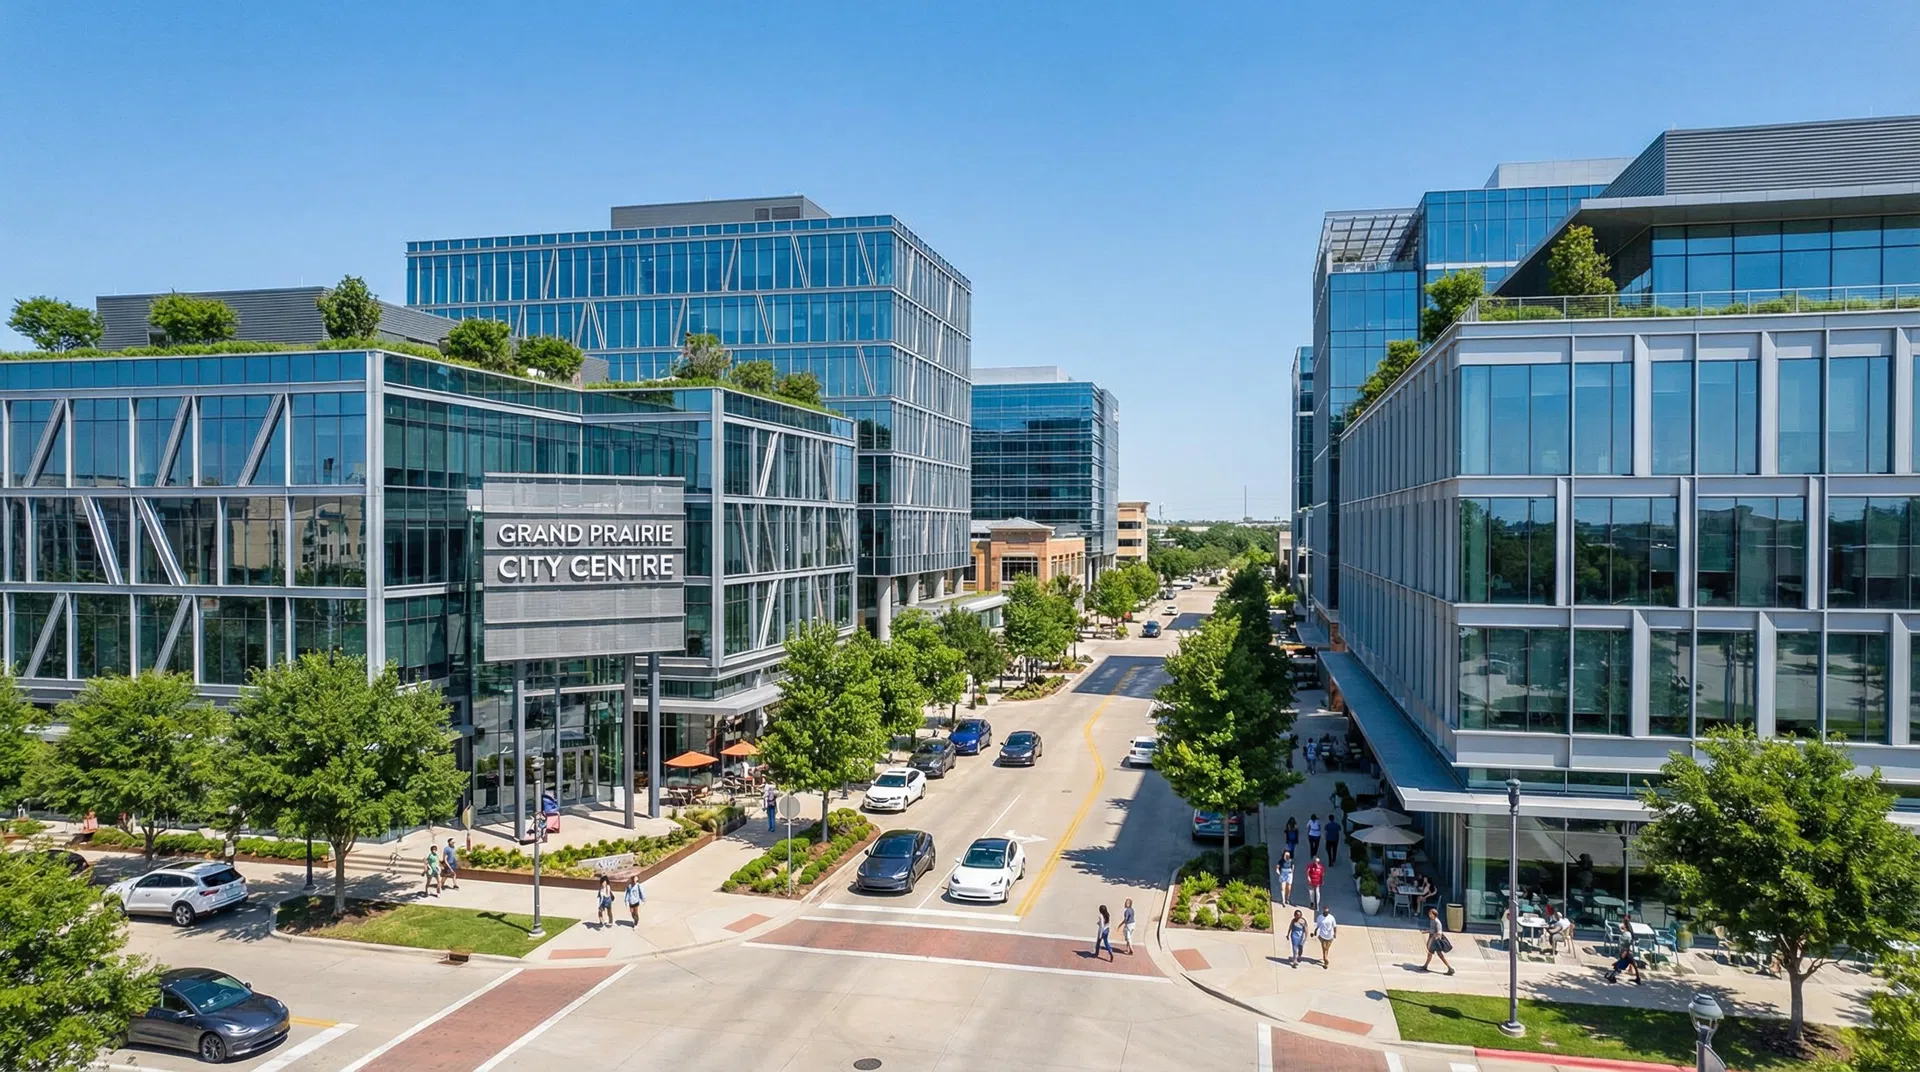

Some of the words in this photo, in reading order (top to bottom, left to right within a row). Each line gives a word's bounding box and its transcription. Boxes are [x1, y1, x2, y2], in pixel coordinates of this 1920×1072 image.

[499, 523, 583, 543] GRAND
[590, 524, 674, 542] PRAIRIE
[499, 556, 563, 578] CITY
[570, 555, 674, 577] CENTRE
